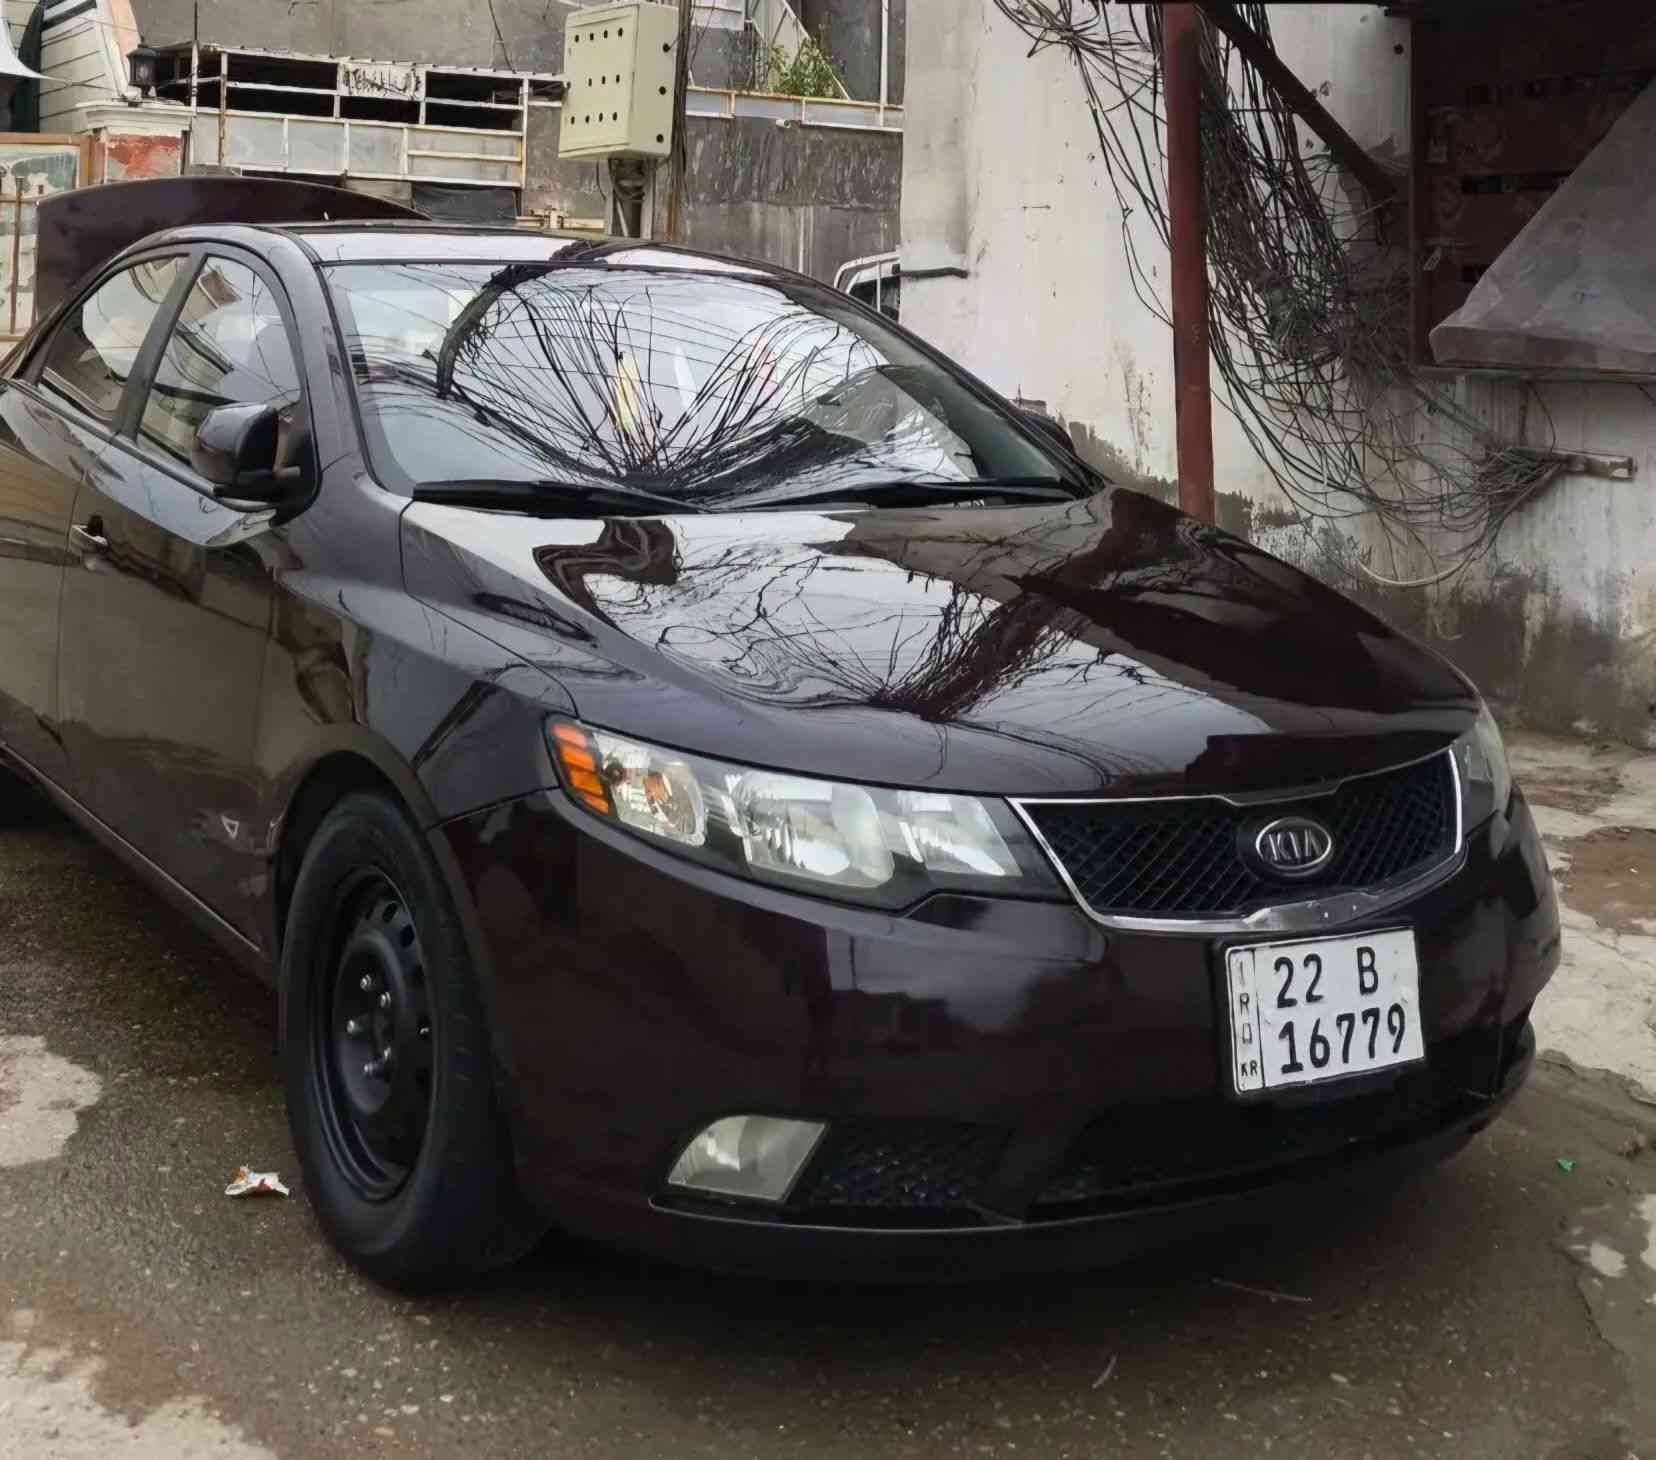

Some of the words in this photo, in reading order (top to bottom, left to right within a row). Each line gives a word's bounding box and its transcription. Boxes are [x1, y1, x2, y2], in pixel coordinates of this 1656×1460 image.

[1267, 829, 1322, 861] KIA
[1274, 953, 1324, 1009] 22
[1357, 946, 1379, 996] B
[1278, 1003, 1406, 1074] 16779
[1240, 1060, 1258, 1077] KR
